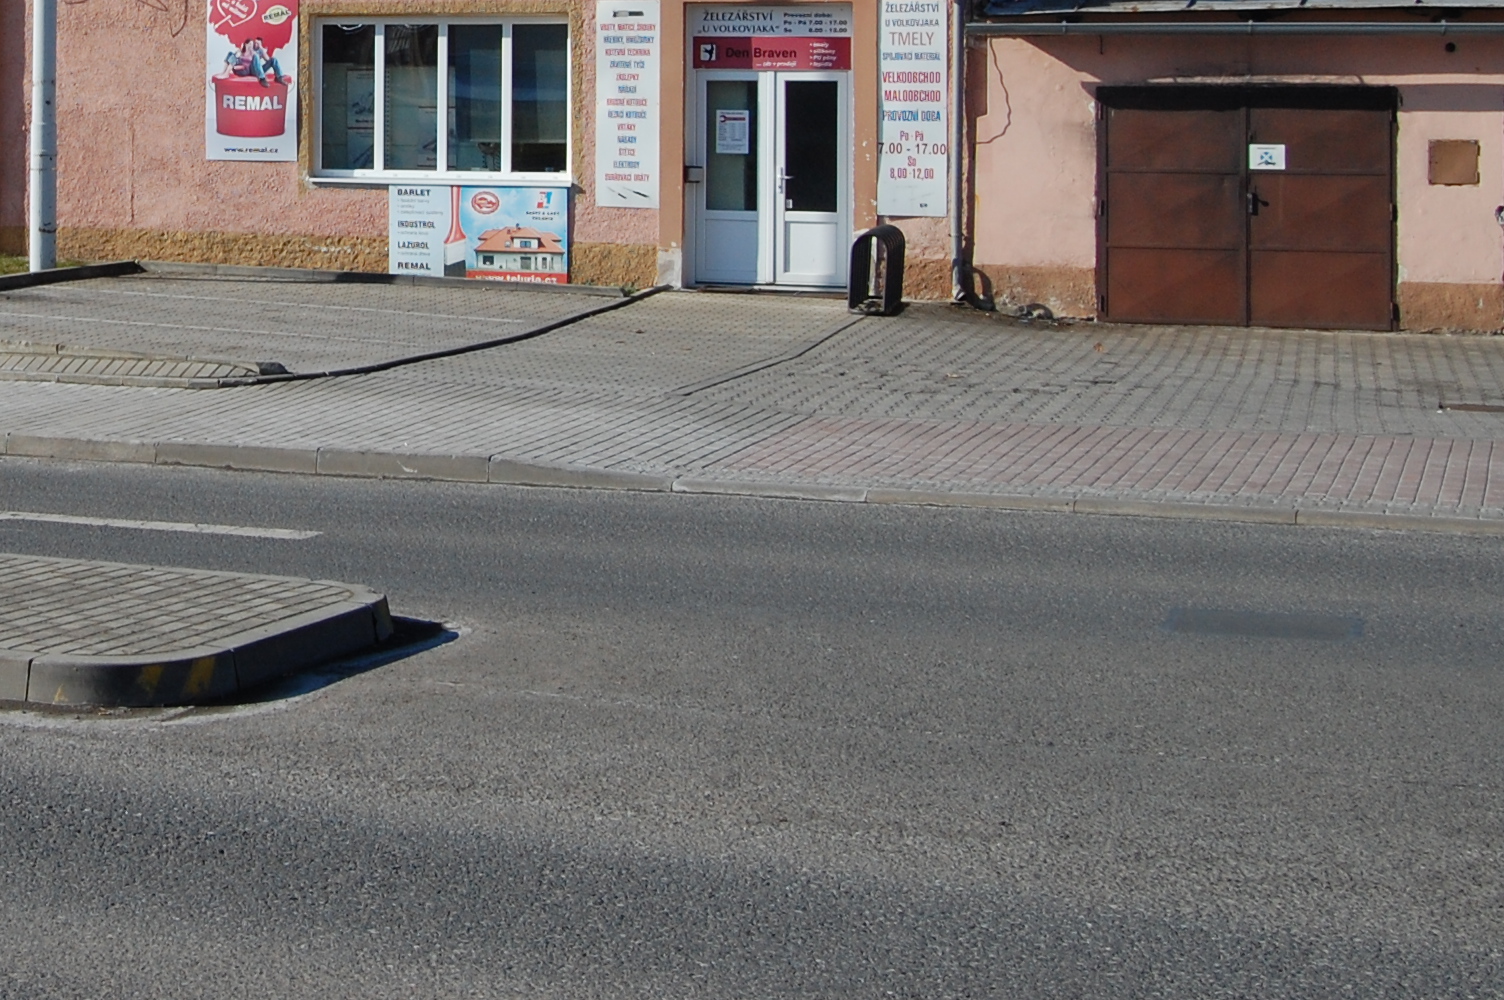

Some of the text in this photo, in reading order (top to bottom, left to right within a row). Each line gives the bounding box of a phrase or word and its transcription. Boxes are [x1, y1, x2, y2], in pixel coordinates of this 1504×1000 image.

[885, 1, 939, 13] ŽELEZÁŘSTVÍ
[263, 9, 289, 21] REMAL
[703, 9, 774, 21] ŽELEZÁŘSTVÍ
[885, 18, 940, 27] U VOLKOVJAKA
[889, 31, 934, 46] TMELY
[726, 47, 797, 58] Den Braven
[882, 71, 941, 84] VELKOOBCHOD
[884, 89, 940, 102] MALOOBCHOD
[223, 94, 283, 110] REMAL
[883, 109, 941, 122] PROVOZNÍ DOBA
[900, 130, 909, 141] Po
[915, 130, 924, 141] Pá
[878, 142, 903, 154] 7.00
[916, 142, 947, 155] 17.00
[907, 155, 917, 167] So
[397, 188, 431, 196] BARLET
[397, 220, 436, 228] INDUSTROL
[397, 241, 430, 249] LAZUROL
[397, 261, 431, 271] REMAL
